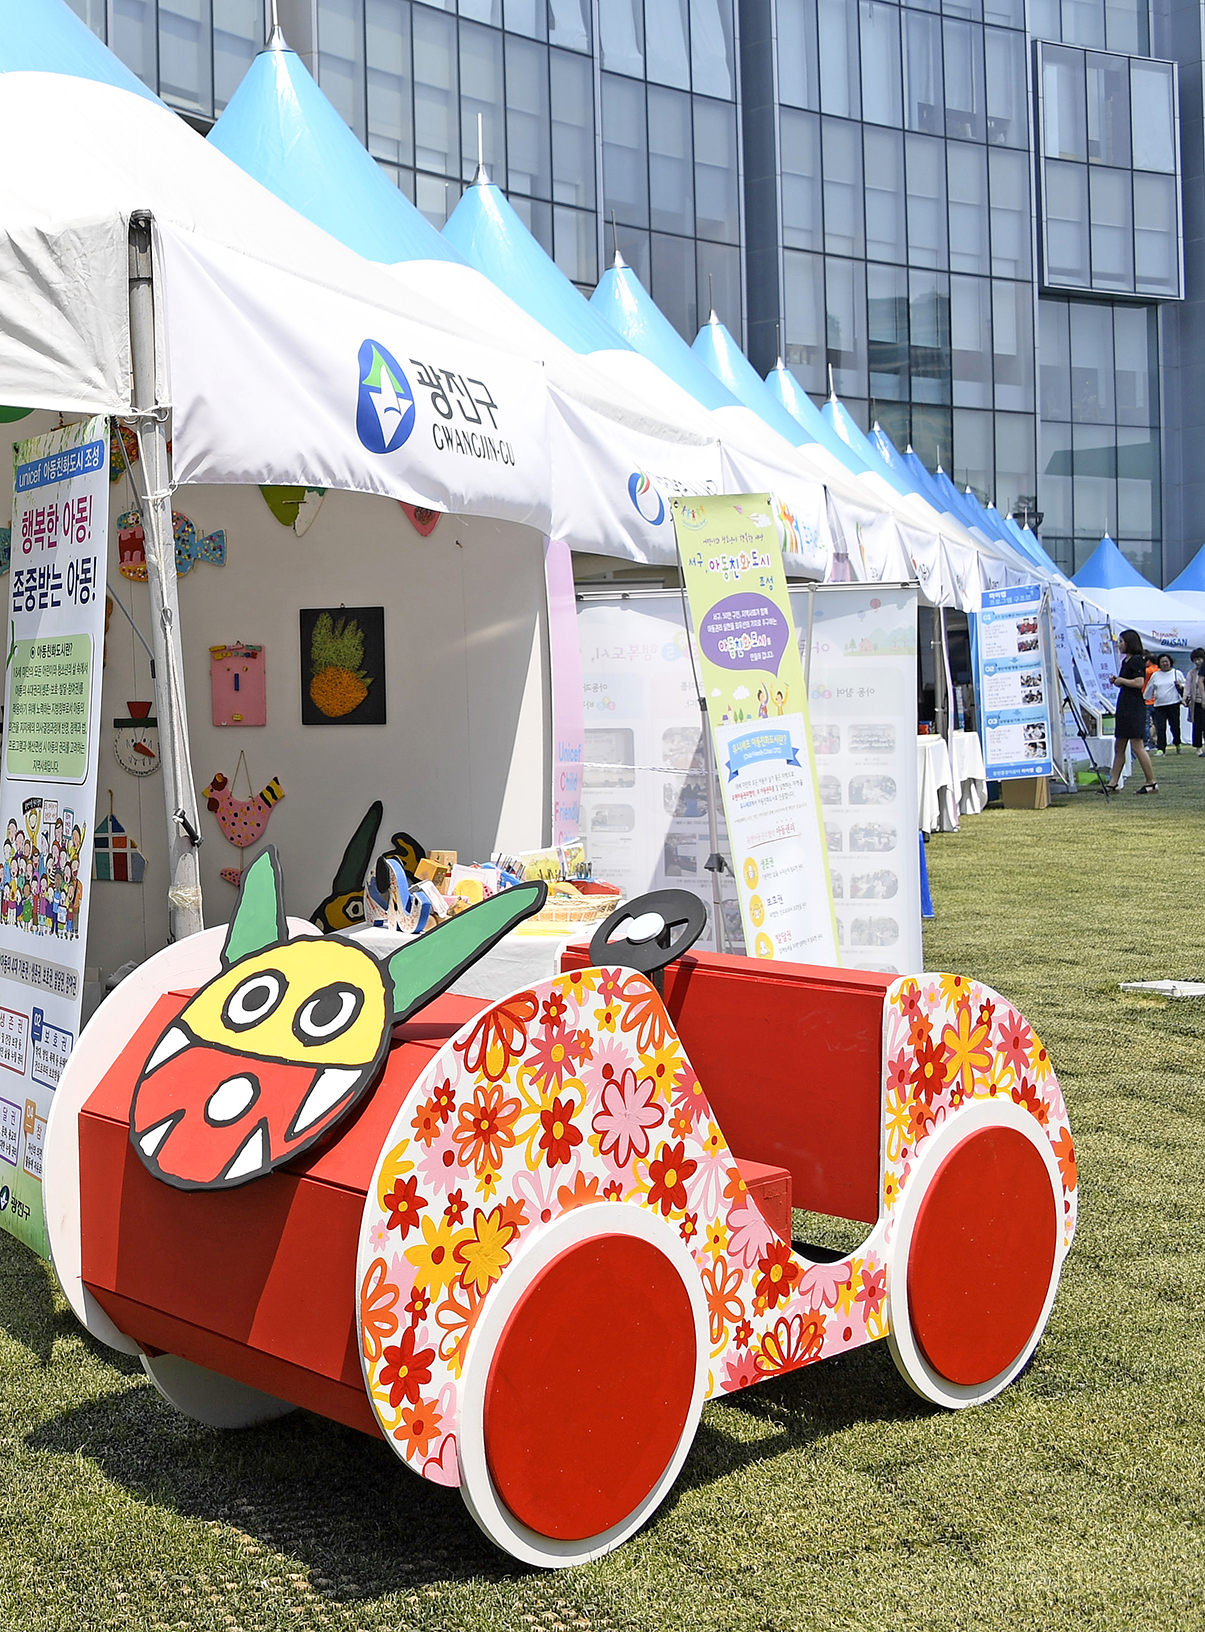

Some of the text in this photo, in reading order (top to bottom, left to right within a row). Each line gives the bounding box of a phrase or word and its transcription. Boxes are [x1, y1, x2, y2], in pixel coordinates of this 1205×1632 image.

[408, 358, 498, 430] 광진구
[19, 445, 100, 487] unicef 아동친화도시 조성
[21, 495, 93, 554] 행복한 아동!
[709, 551, 770, 579] 아동친화도시
[12, 556, 97, 612] 존중받는 아동!
[759, 576, 774, 591] 조성
[1161, 638, 1188, 647] BUSAN
[558, 742, 581, 762] Unicef
[560, 772, 578, 791] Child
[555, 801, 580, 824] Friendly
[10, 1196, 31, 1221] 광진구
